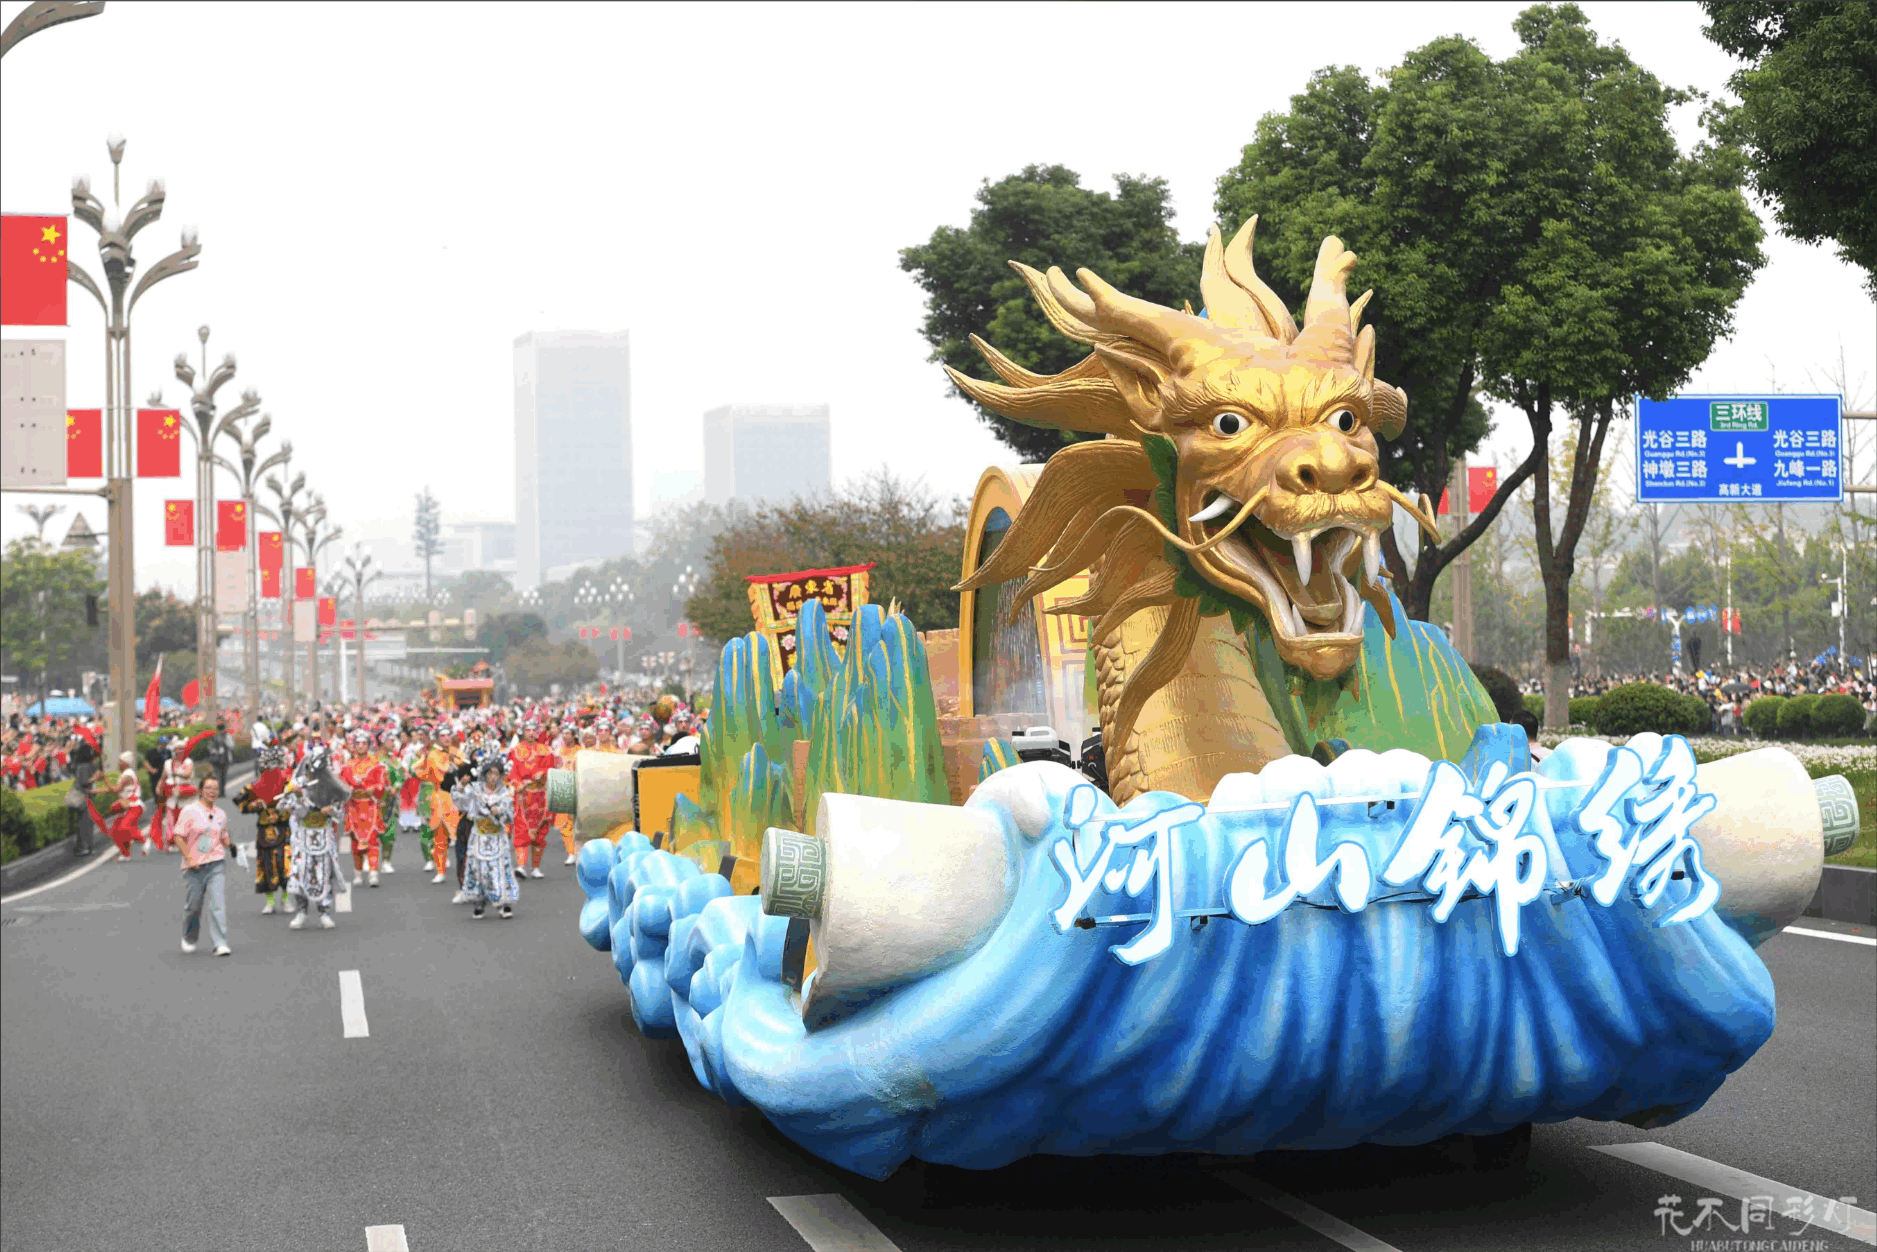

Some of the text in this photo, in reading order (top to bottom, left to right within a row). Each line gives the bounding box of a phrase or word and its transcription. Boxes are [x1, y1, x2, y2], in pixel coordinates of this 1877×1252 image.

[1714, 403, 1762, 422] 三环线
[1642, 429, 1707, 448] 光谷三路
[1773, 429, 1836, 448] 光谷三路
[1642, 459, 1707, 479] 神墩三路
[1773, 459, 1836, 478] 九峰一路
[1718, 483, 1762, 496] 高新大道
